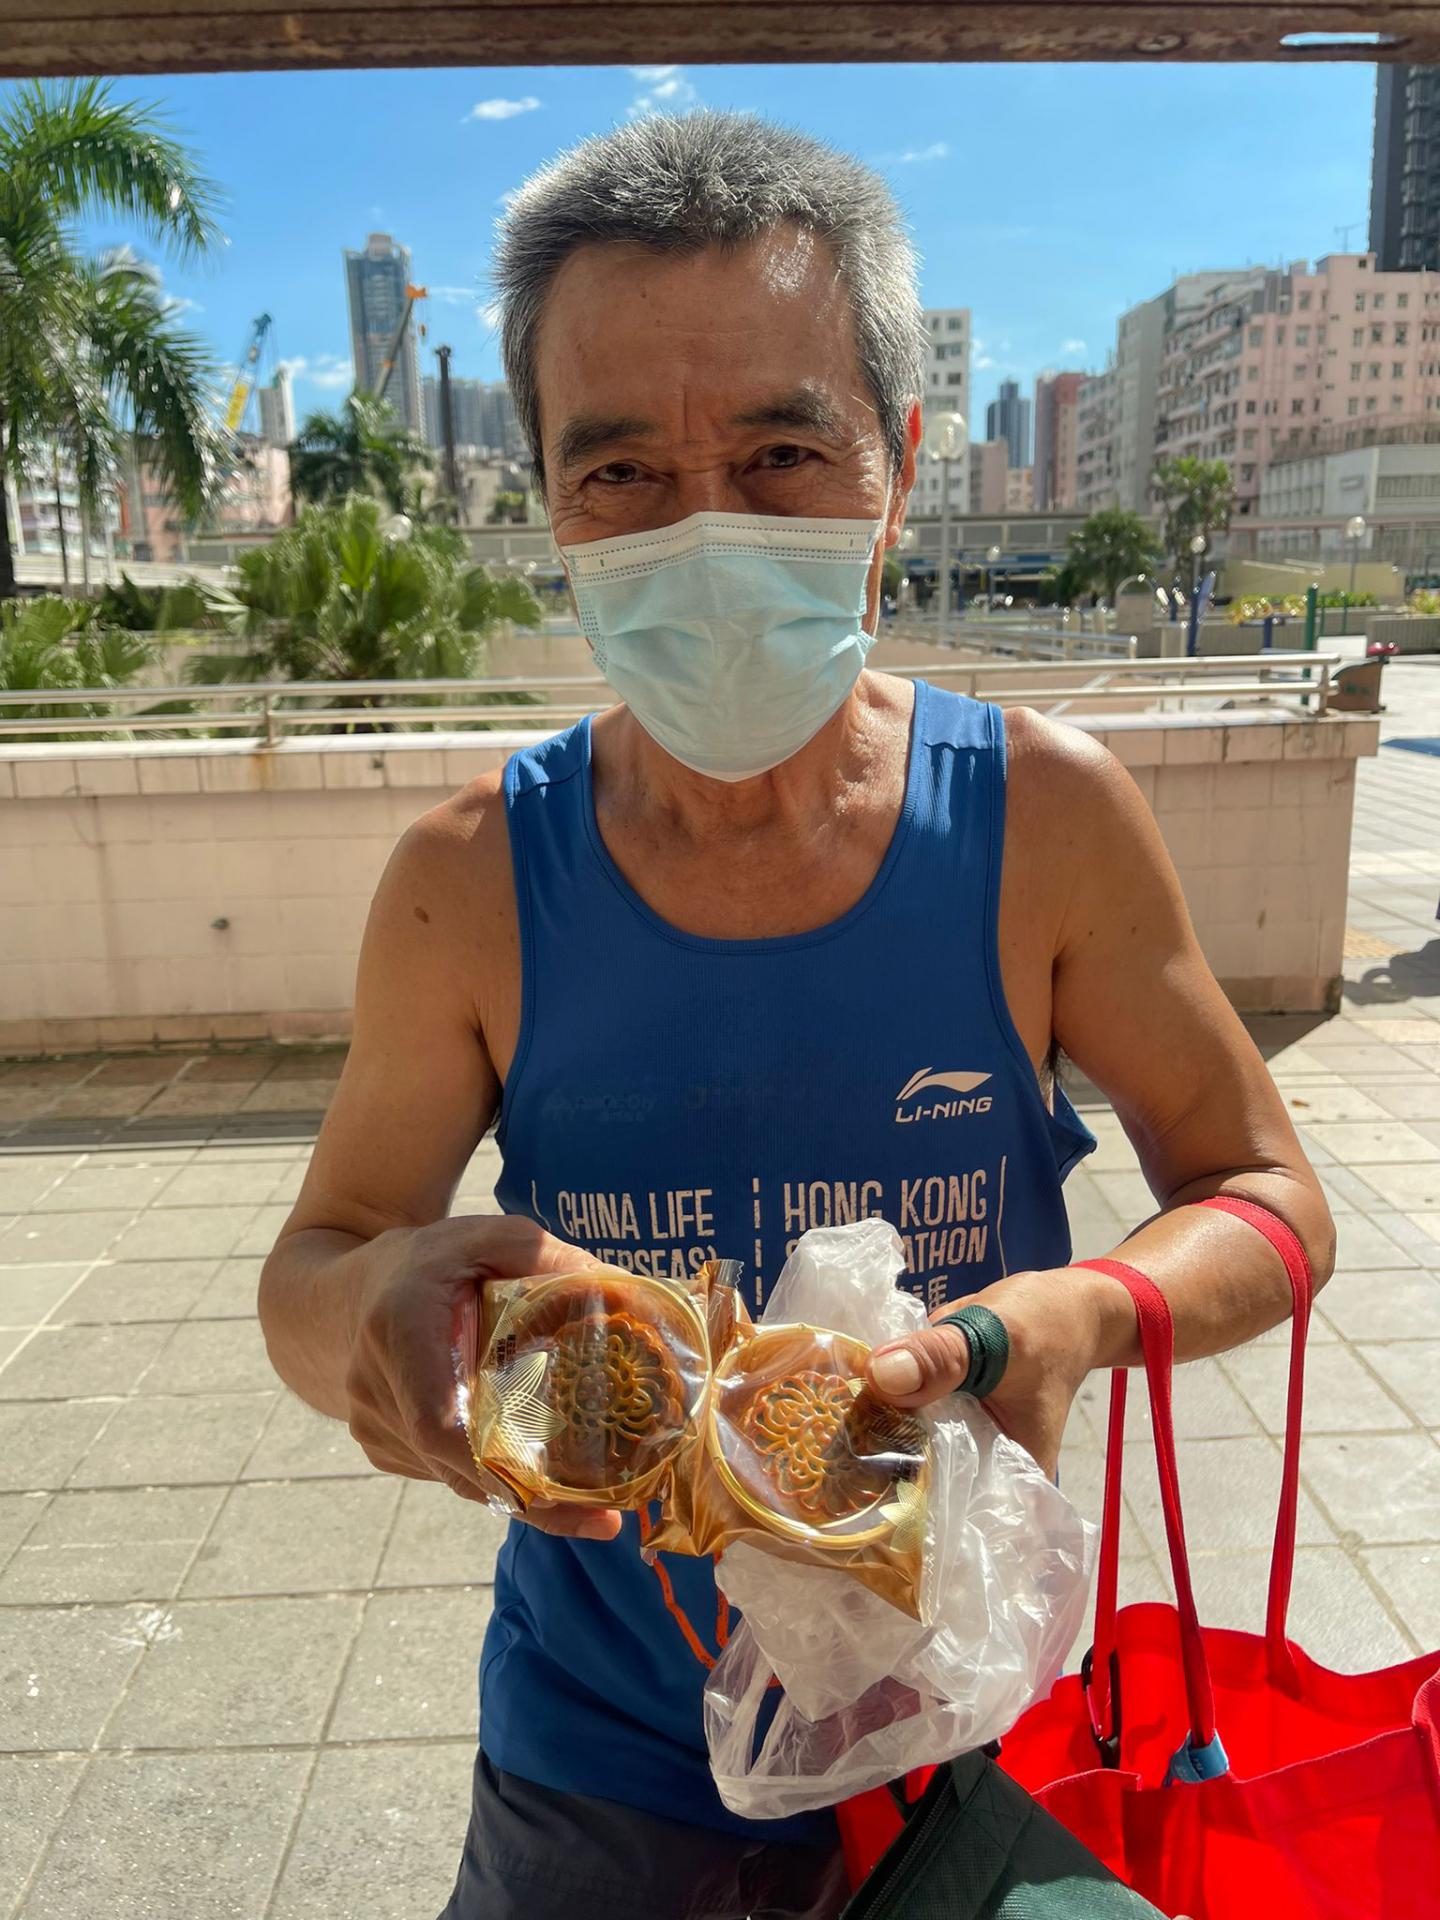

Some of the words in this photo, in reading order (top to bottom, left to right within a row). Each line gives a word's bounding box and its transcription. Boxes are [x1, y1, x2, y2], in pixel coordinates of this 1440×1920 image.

[895, 1096, 993, 1123] LI-NING
[557, 1190, 641, 1240] CHINA
[648, 1188, 716, 1240] LIFE
[783, 1180, 884, 1233] HONG
[901, 1169, 988, 1229] KONG
